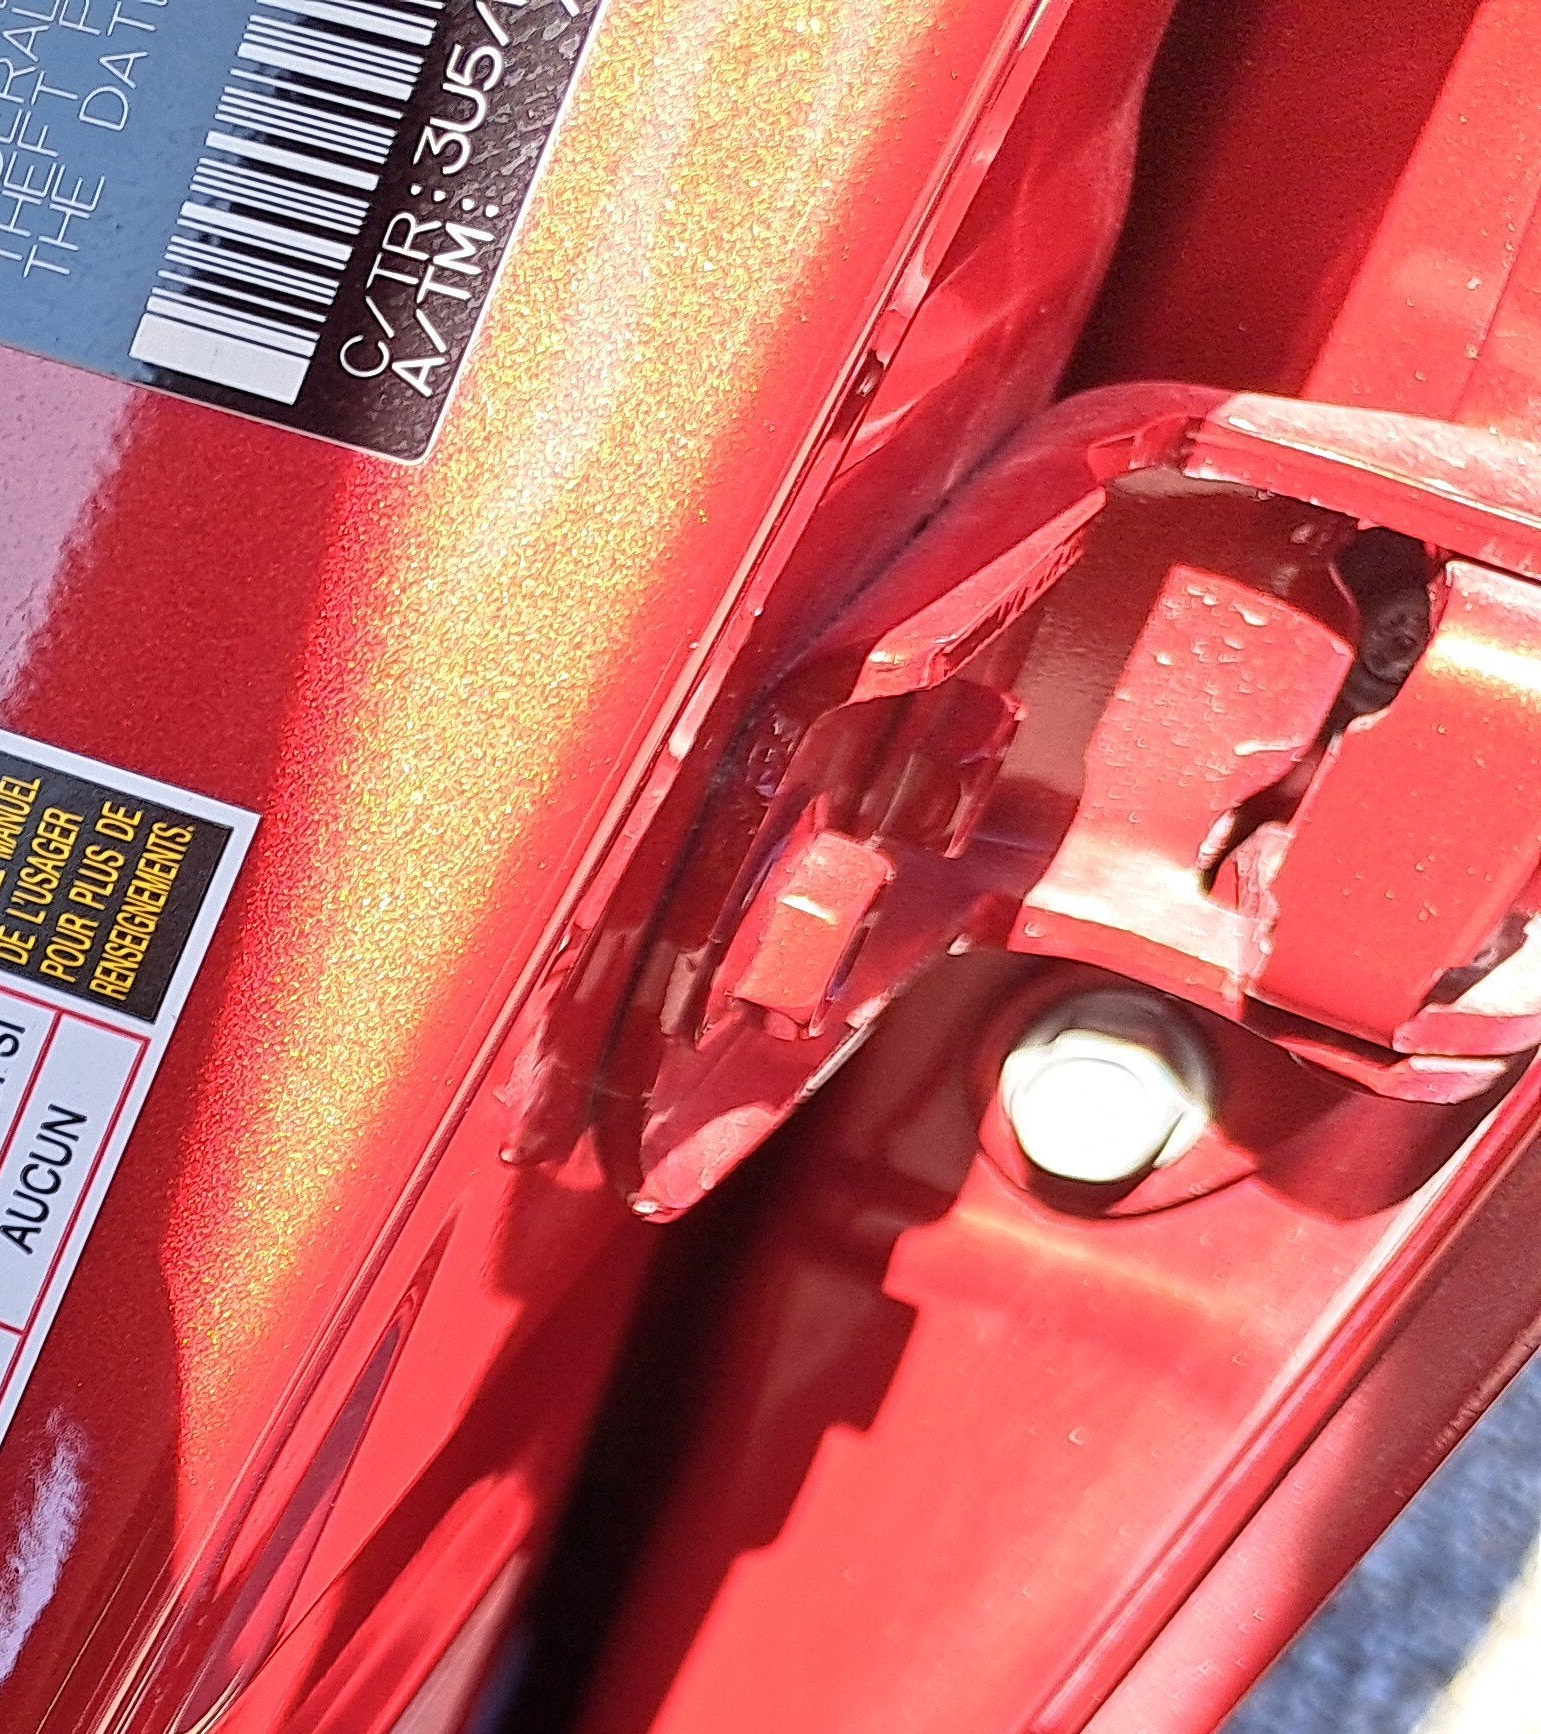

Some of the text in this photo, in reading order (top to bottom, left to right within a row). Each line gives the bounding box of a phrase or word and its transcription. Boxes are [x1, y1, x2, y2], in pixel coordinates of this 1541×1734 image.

[23, 165, 105, 278] THE
[8, 807, 83, 924] L'USAGER
[40, 802, 143, 983] POUR PLUS DE
[89, 822, 194, 1001] RENSEIGNEMENTS.
